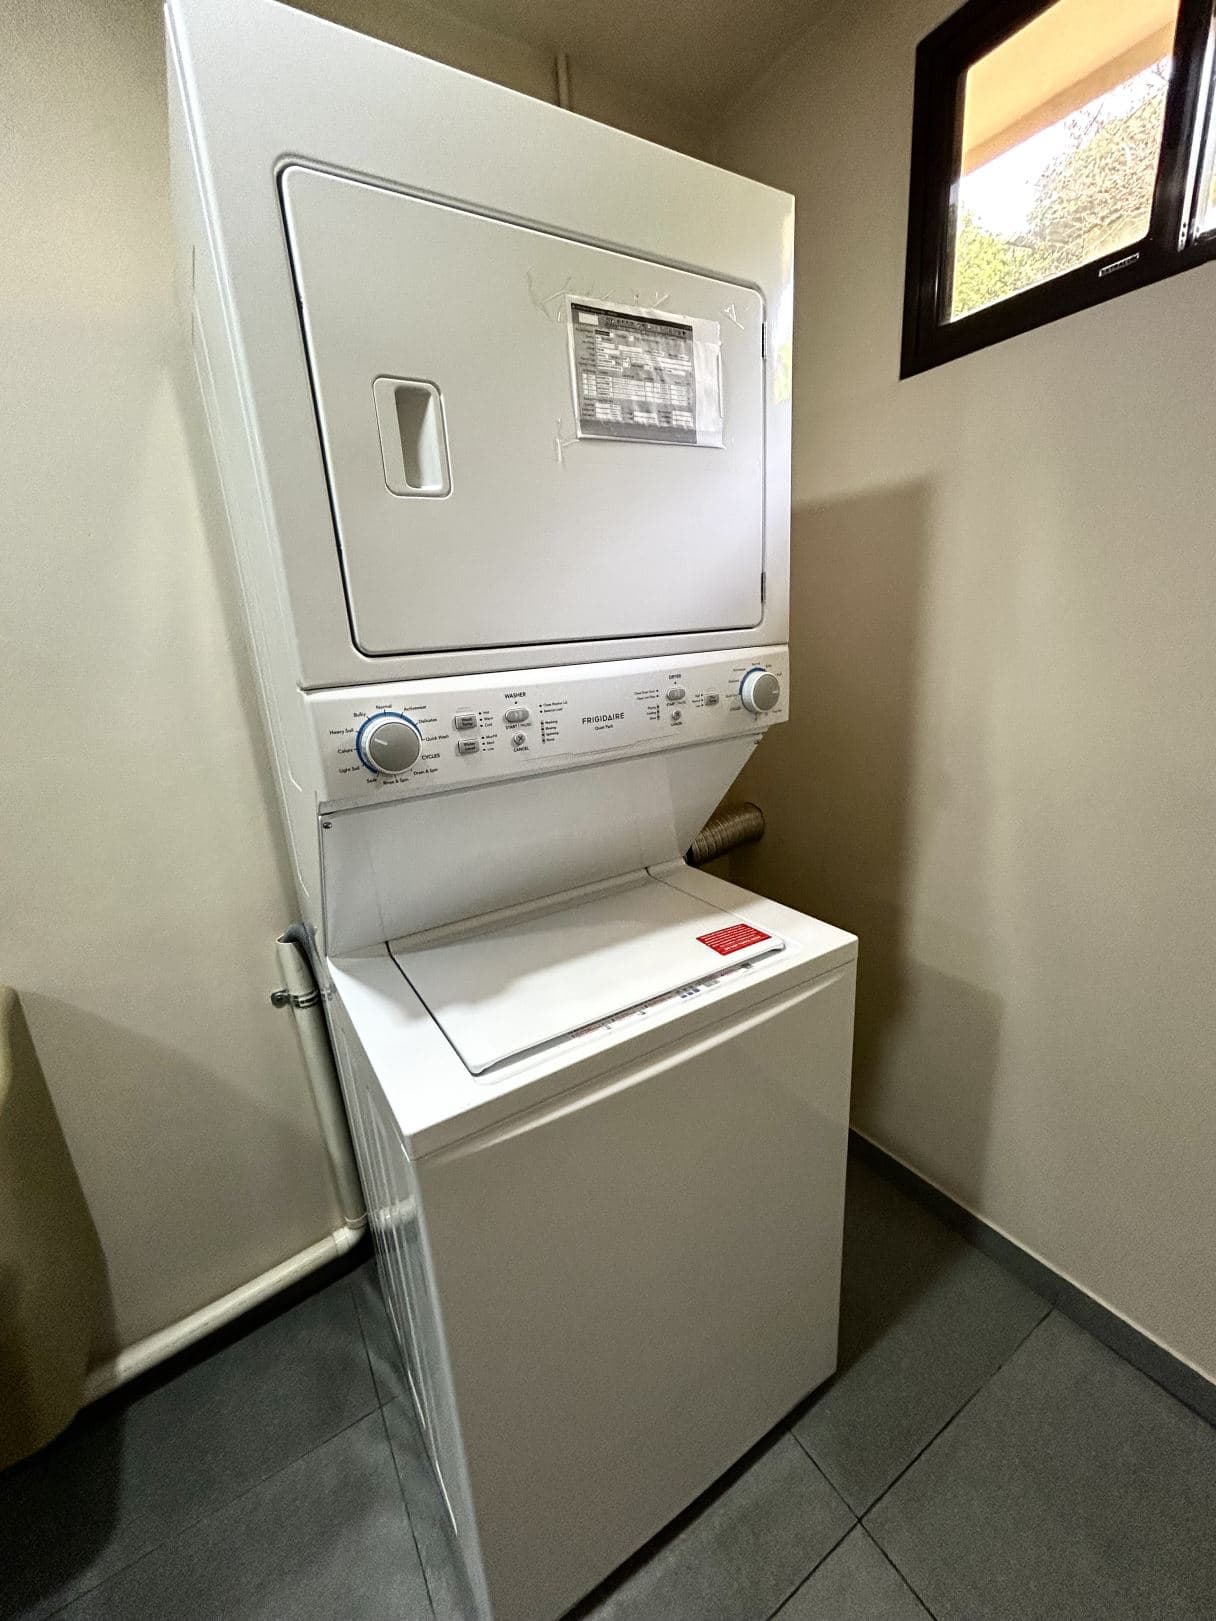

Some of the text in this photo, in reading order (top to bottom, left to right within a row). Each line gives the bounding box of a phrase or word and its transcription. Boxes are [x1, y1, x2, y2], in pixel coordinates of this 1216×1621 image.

[504, 691, 526, 699] WASHER
[581, 711, 625, 725] FRIGIDAIRE
[421, 753, 441, 761] CYCLES
